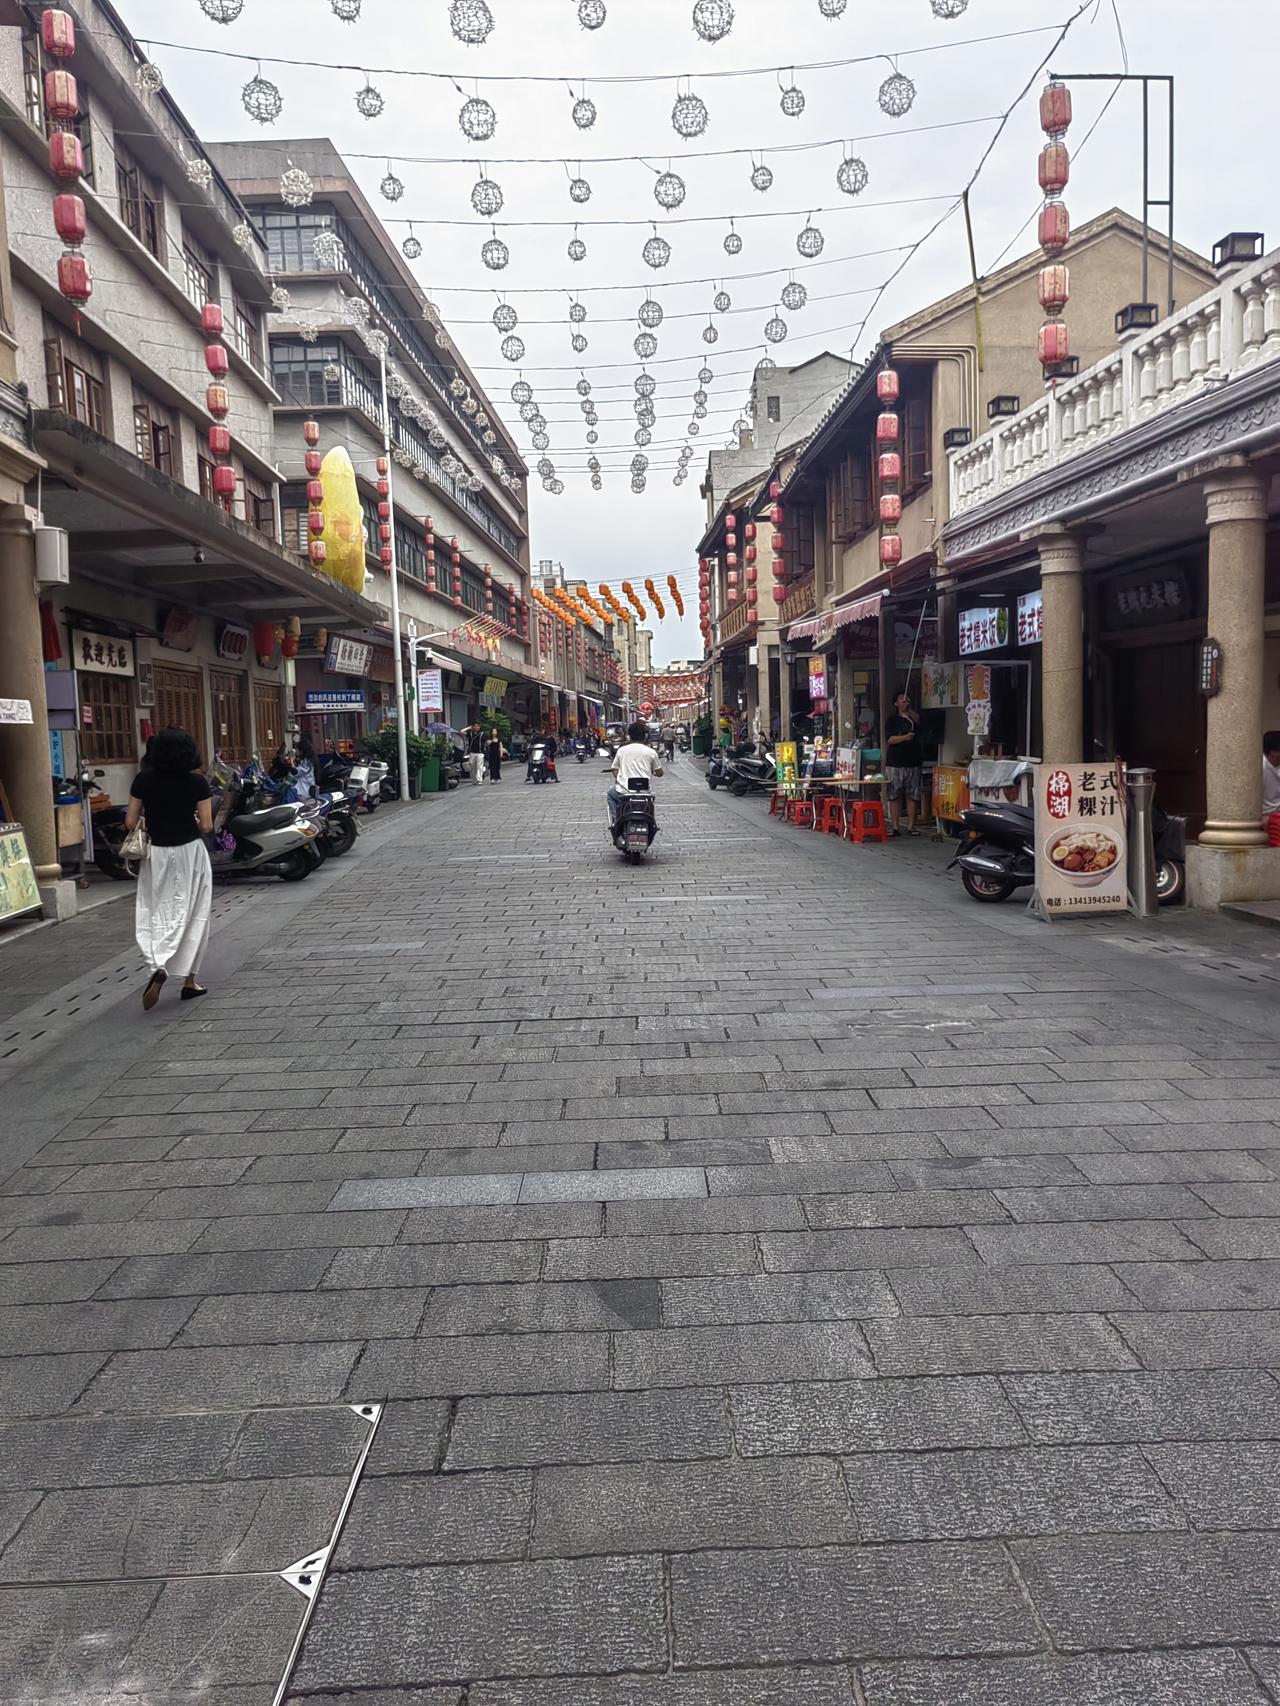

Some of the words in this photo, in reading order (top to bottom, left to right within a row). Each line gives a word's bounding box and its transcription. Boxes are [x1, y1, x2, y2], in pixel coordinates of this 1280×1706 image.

[1077, 771, 1117, 791] 老式
[1049, 772, 1069, 817] 棉湖
[1077, 796, 1118, 817] 粿汁
